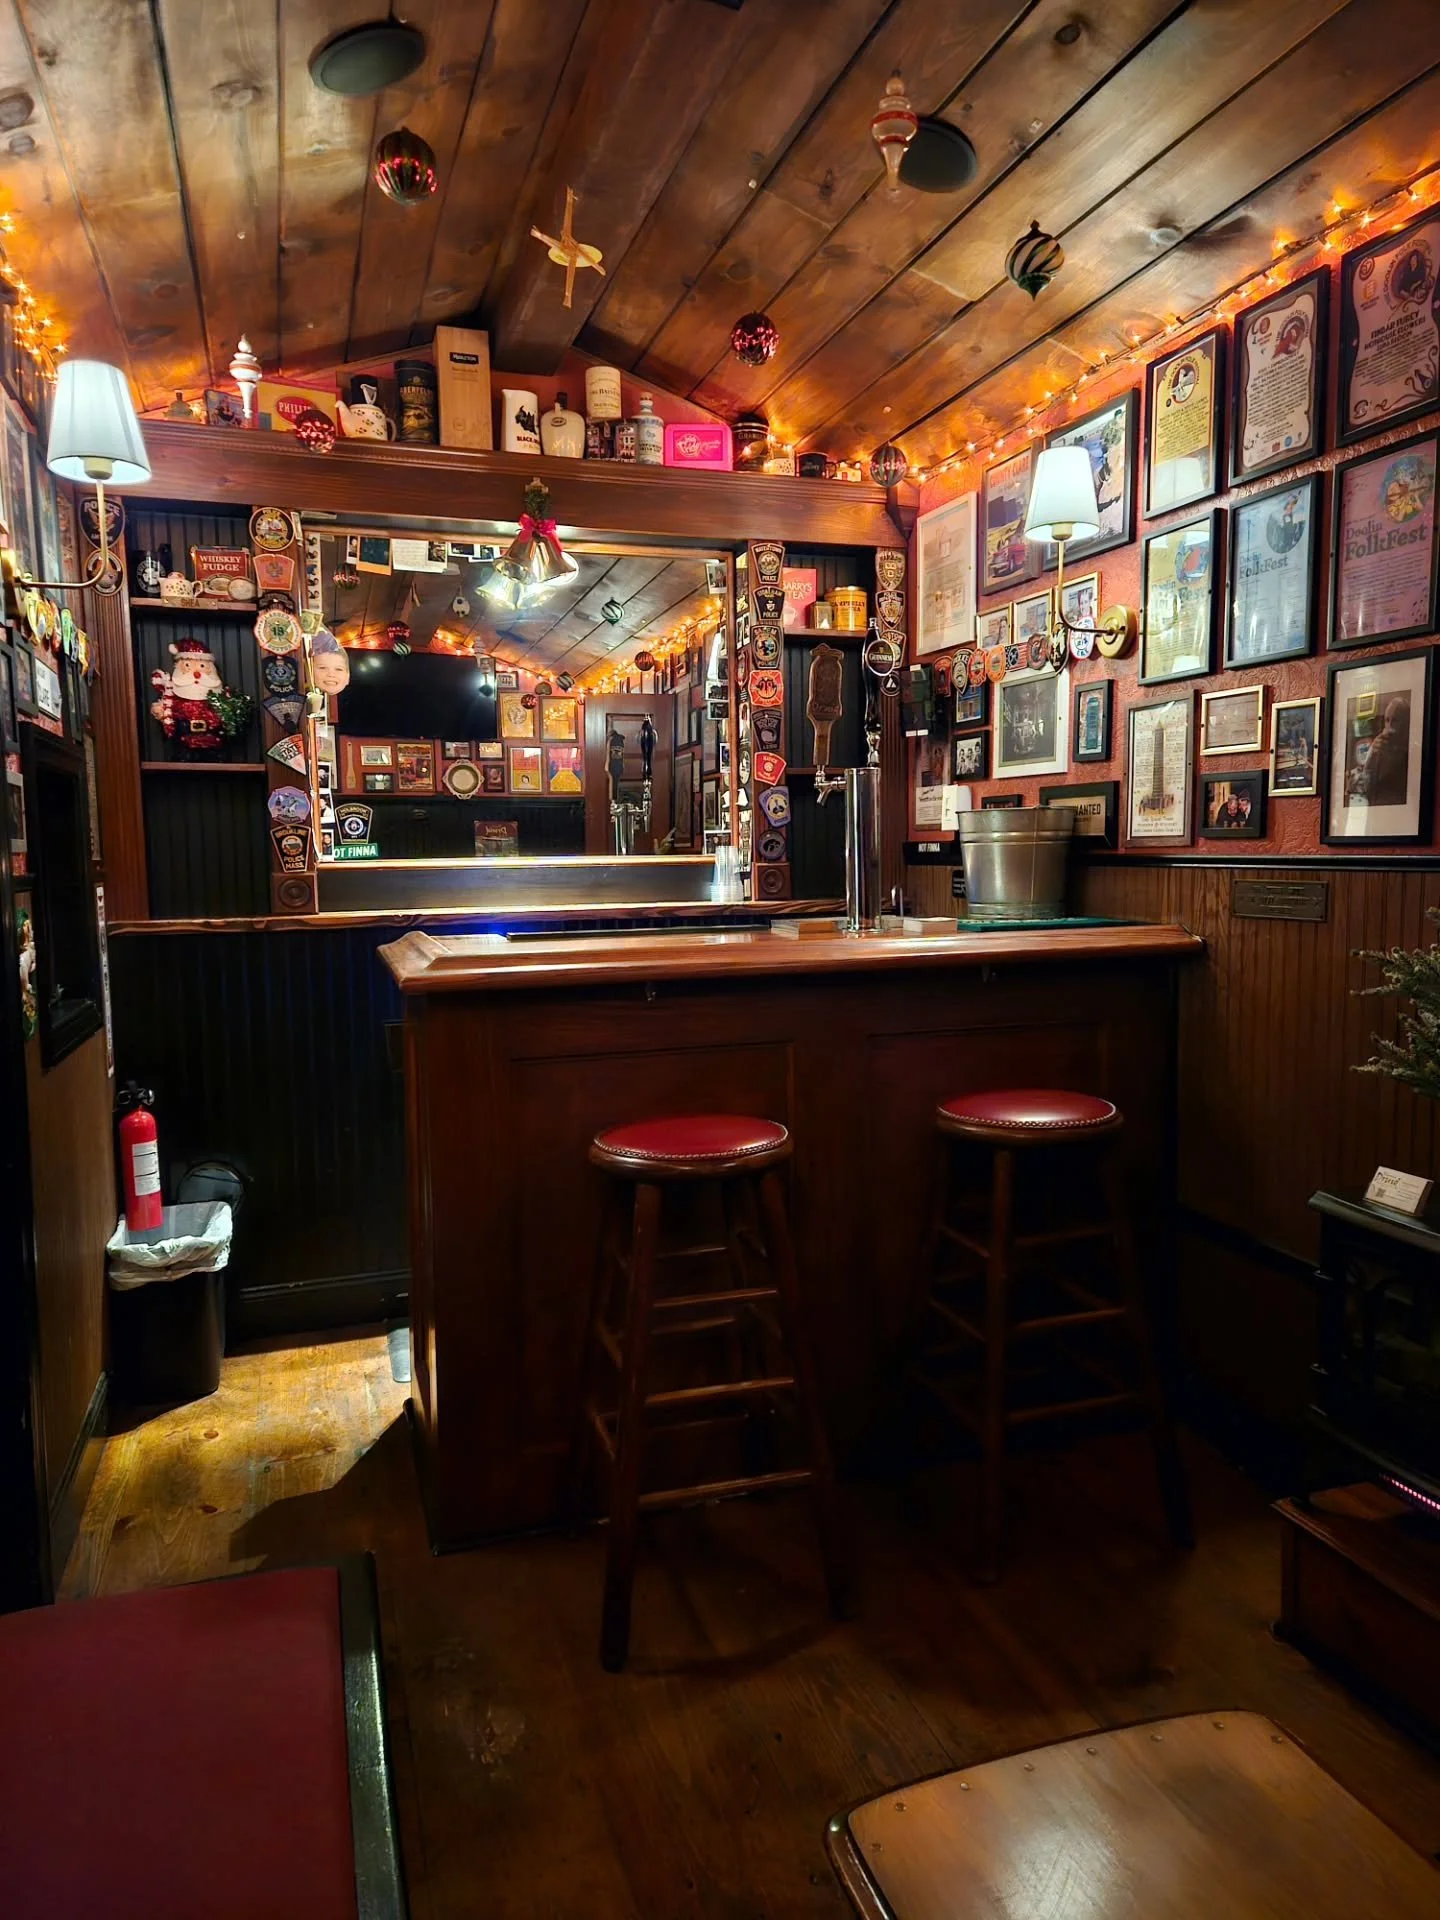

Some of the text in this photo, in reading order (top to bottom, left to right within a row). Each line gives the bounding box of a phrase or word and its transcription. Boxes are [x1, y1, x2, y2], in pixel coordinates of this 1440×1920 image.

[1346, 518, 1383, 541] Doolin
[1345, 522, 1429, 562] FolkFest
[199, 555, 241, 564] WHISKEY
[203, 563, 240, 571] FUDGE
[1239, 556, 1289, 579] FolkFest
[182, 599, 201, 608] SHEA
[763, 611, 778, 619] POLICE
[870, 652, 893, 662] GUINNESS
[334, 845, 377, 858] OT FINNA
